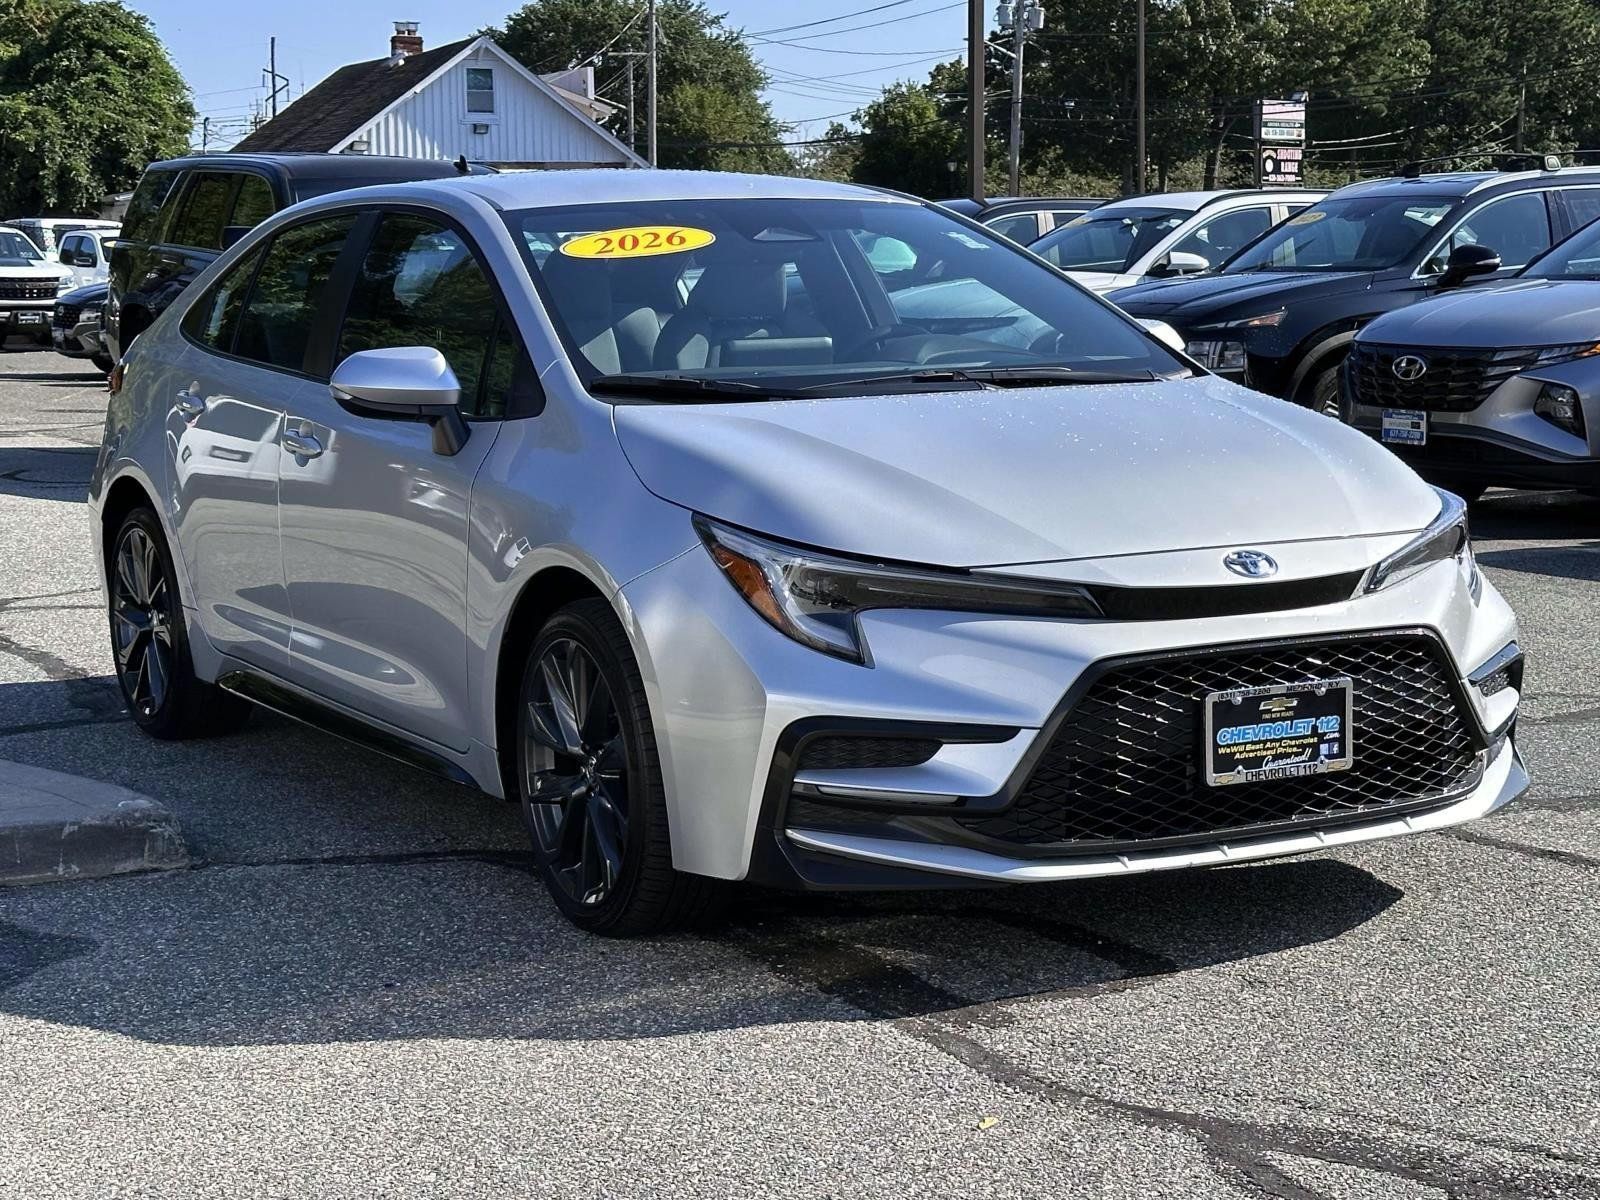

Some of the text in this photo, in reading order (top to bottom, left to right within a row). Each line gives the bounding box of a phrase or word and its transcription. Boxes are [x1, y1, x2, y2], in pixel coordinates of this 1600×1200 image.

[1277, 149, 1302, 160] SHOOTING
[1281, 162, 1298, 172] RANGE
[593, 230, 686, 254] 2026
[1286, 682, 1323, 693] MEDFORD
[1217, 716, 1340, 745] CHEVROLET 112
[1265, 740, 1280, 748] Any
[1281, 736, 1318, 746] Chevrolet
[1234, 749, 1276, 760] Advertised
[1246, 764, 1318, 782] CHEVROLET 112
